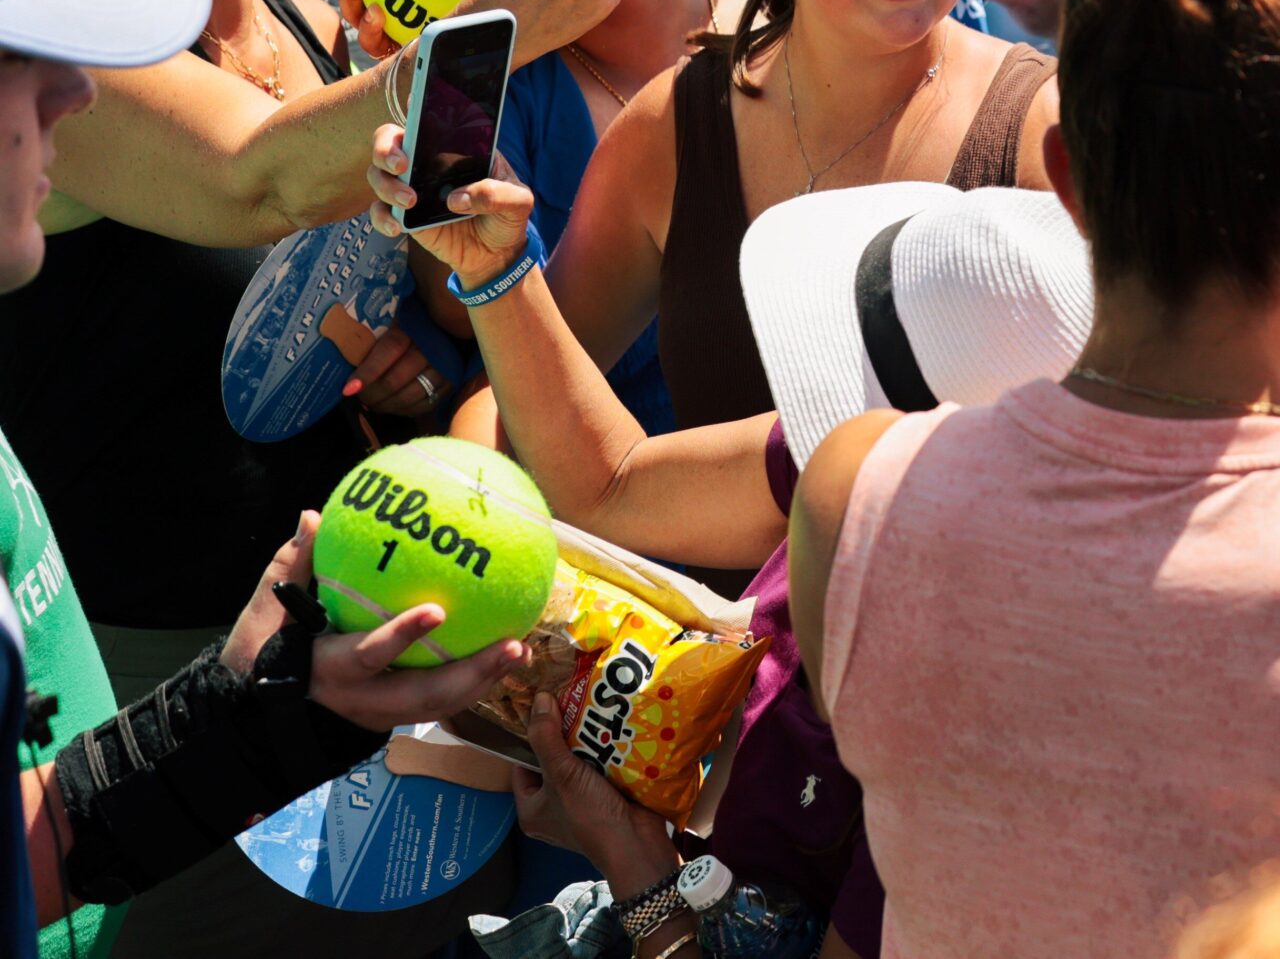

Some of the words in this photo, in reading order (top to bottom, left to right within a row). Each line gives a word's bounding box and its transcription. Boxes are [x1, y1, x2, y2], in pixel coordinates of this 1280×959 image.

[487, 289, 498, 297] &
[494, 256, 534, 293] SOUTHERN
[342, 468, 492, 579] Wilson
[376, 539, 399, 573] 1
[334, 791, 342, 811] THE
[335, 814, 345, 827] BY
[449, 832, 458, 859] Western
[455, 793, 465, 823] Southern
[337, 830, 347, 863] SWING
[420, 793, 443, 890] WesternSouthern.com/fan
